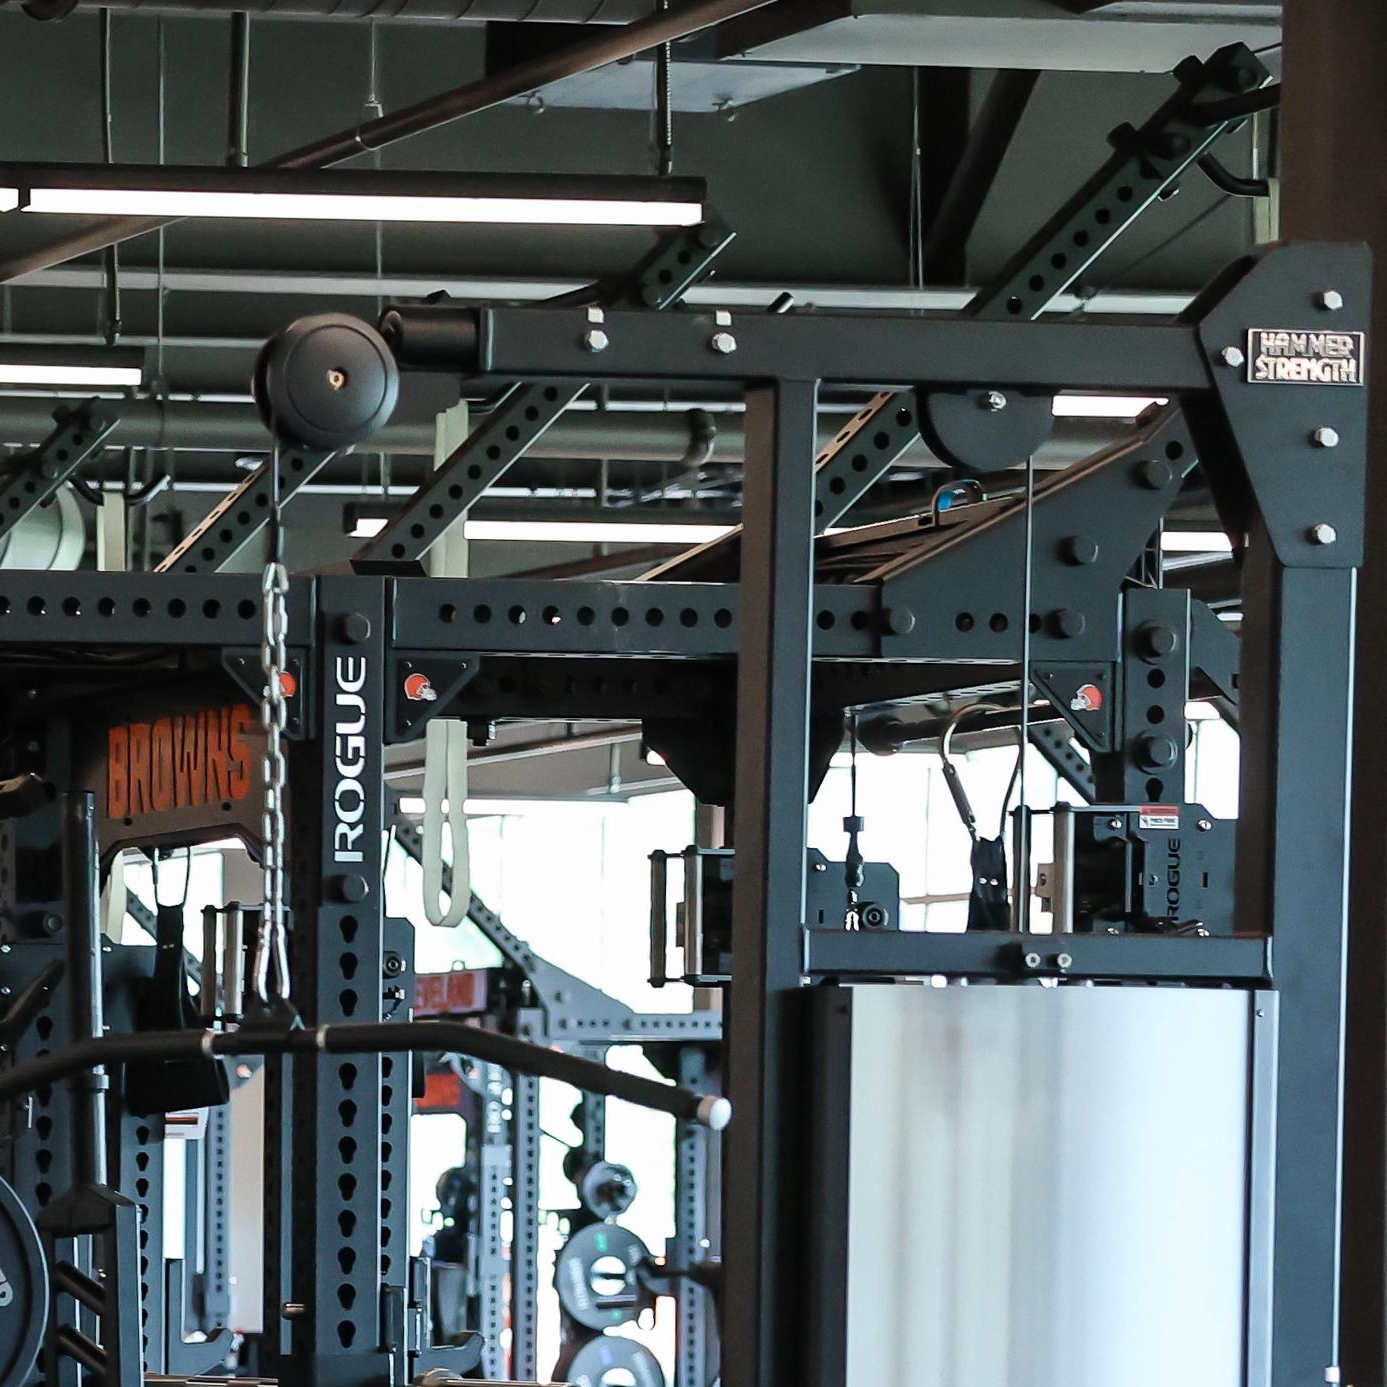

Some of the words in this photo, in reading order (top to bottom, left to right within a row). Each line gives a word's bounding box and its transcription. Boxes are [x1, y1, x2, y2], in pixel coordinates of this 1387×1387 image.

[1255, 354, 1358, 383] STRENGTH
[1259, 331, 1355, 358] HAMMER
[107, 702, 251, 820] BROWNS
[333, 655, 367, 863] ROGUE
[1167, 837, 1181, 921] ROGUE
